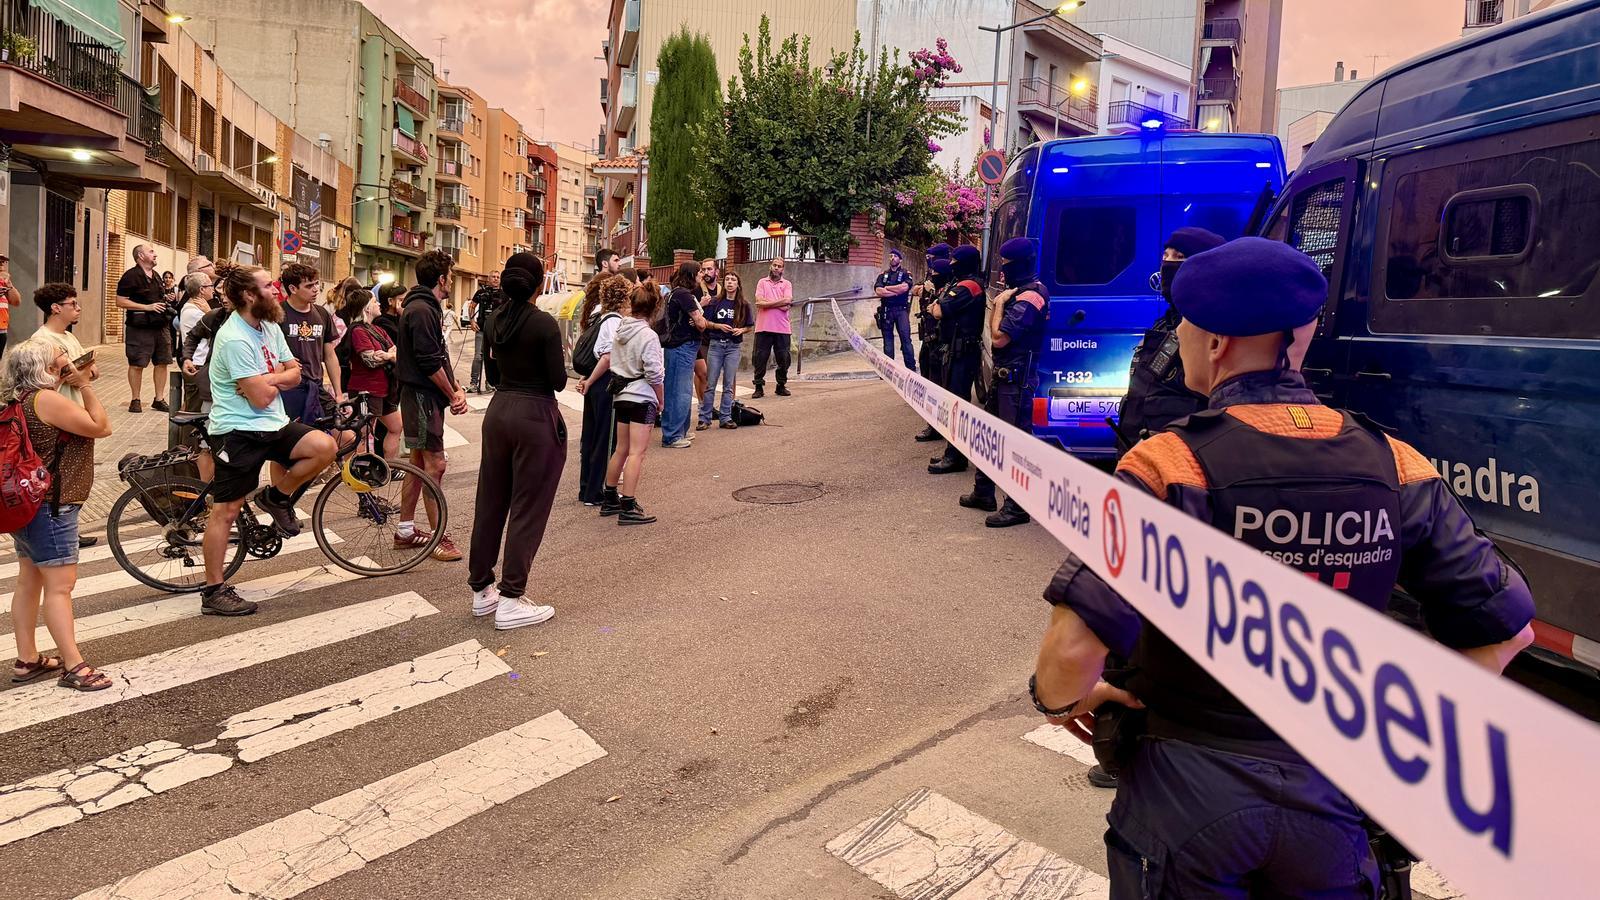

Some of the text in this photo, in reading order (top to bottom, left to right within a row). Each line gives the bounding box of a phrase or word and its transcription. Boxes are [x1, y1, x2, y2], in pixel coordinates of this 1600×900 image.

[289, 323, 323, 336] 18 99
[1063, 340, 1097, 351] policia
[1053, 371, 1093, 384] T-832
[1068, 401, 1092, 414] CME
[958, 410, 969, 443] no
[970, 416, 1005, 472] passeu
[1048, 478, 1090, 539] policia
[1233, 505, 1395, 546] POLICIA
[1308, 546, 1393, 569] d'esquadra
[1140, 517, 1514, 861] no passeu
